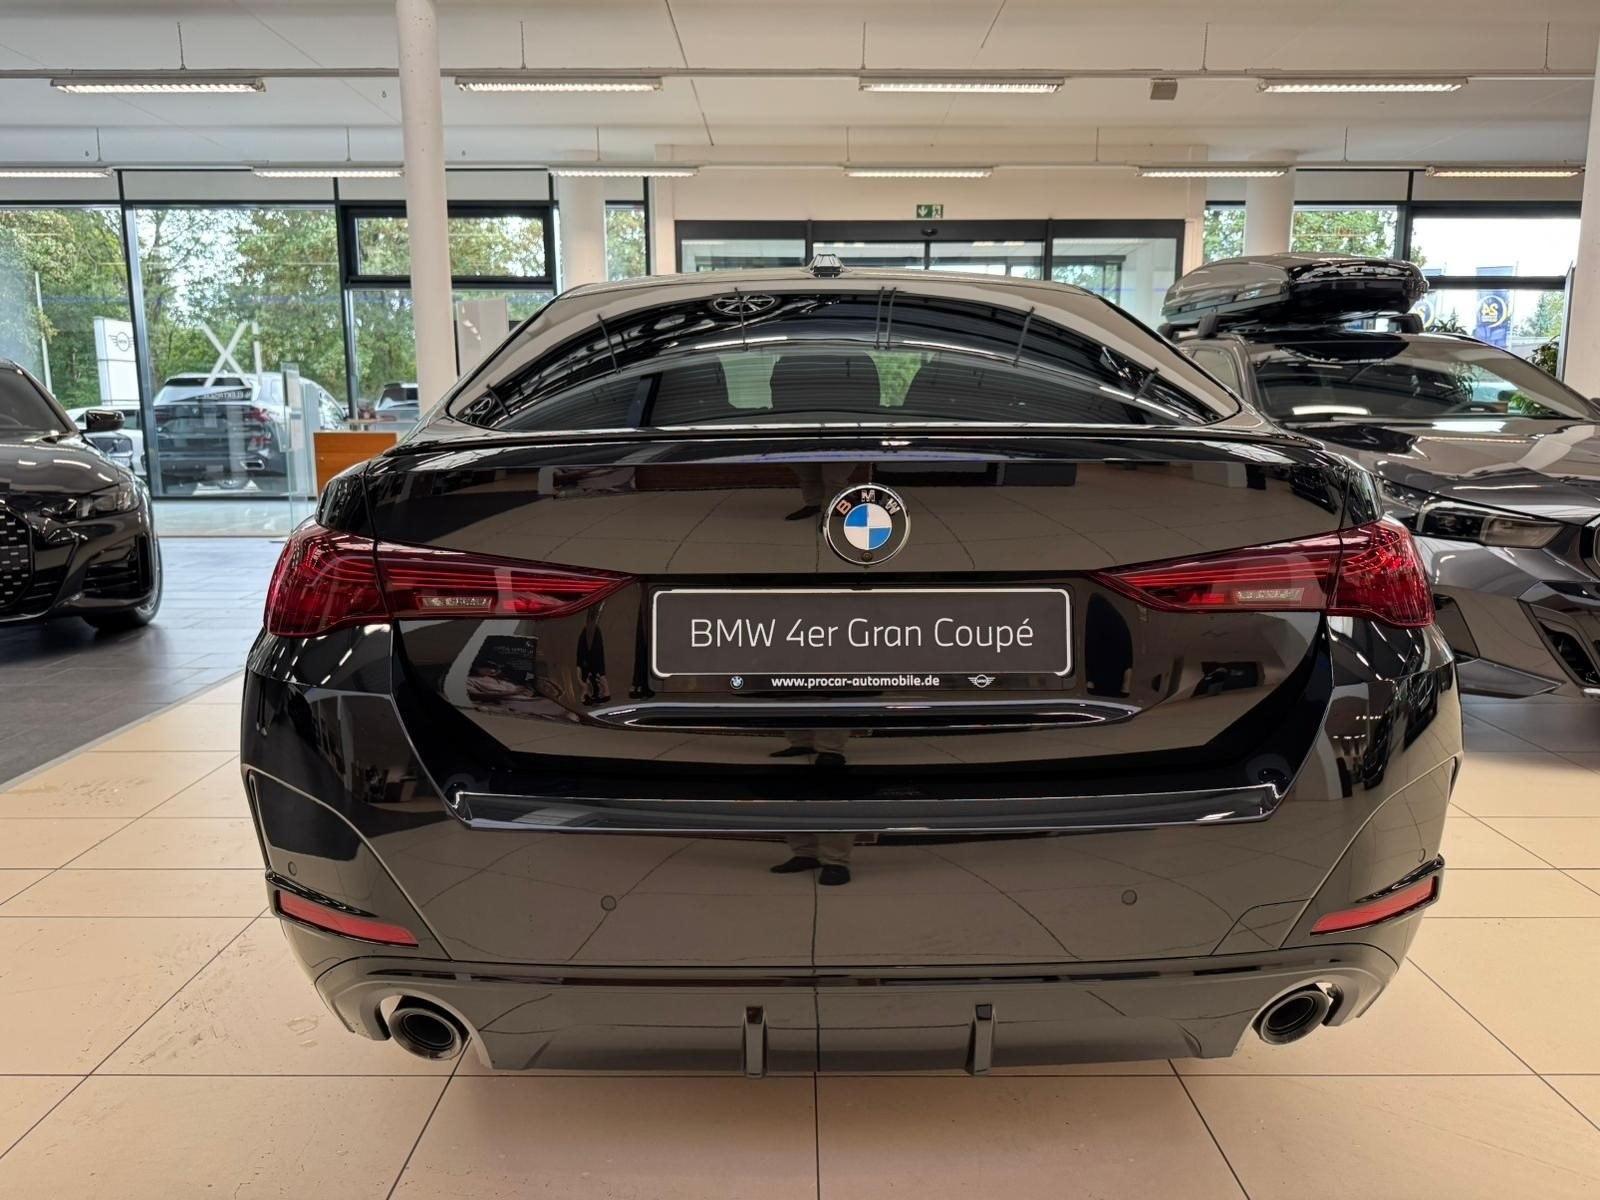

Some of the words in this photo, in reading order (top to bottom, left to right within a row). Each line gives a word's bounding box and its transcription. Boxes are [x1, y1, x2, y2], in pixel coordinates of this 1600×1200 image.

[836, 489, 901, 515] BMW
[691, 618, 776, 647] BMW
[786, 618, 839, 647] 4er
[848, 617, 922, 647] Gran
[934, 617, 1034, 653] Coupé
[771, 674, 940, 688] www.procar-automobile.de
